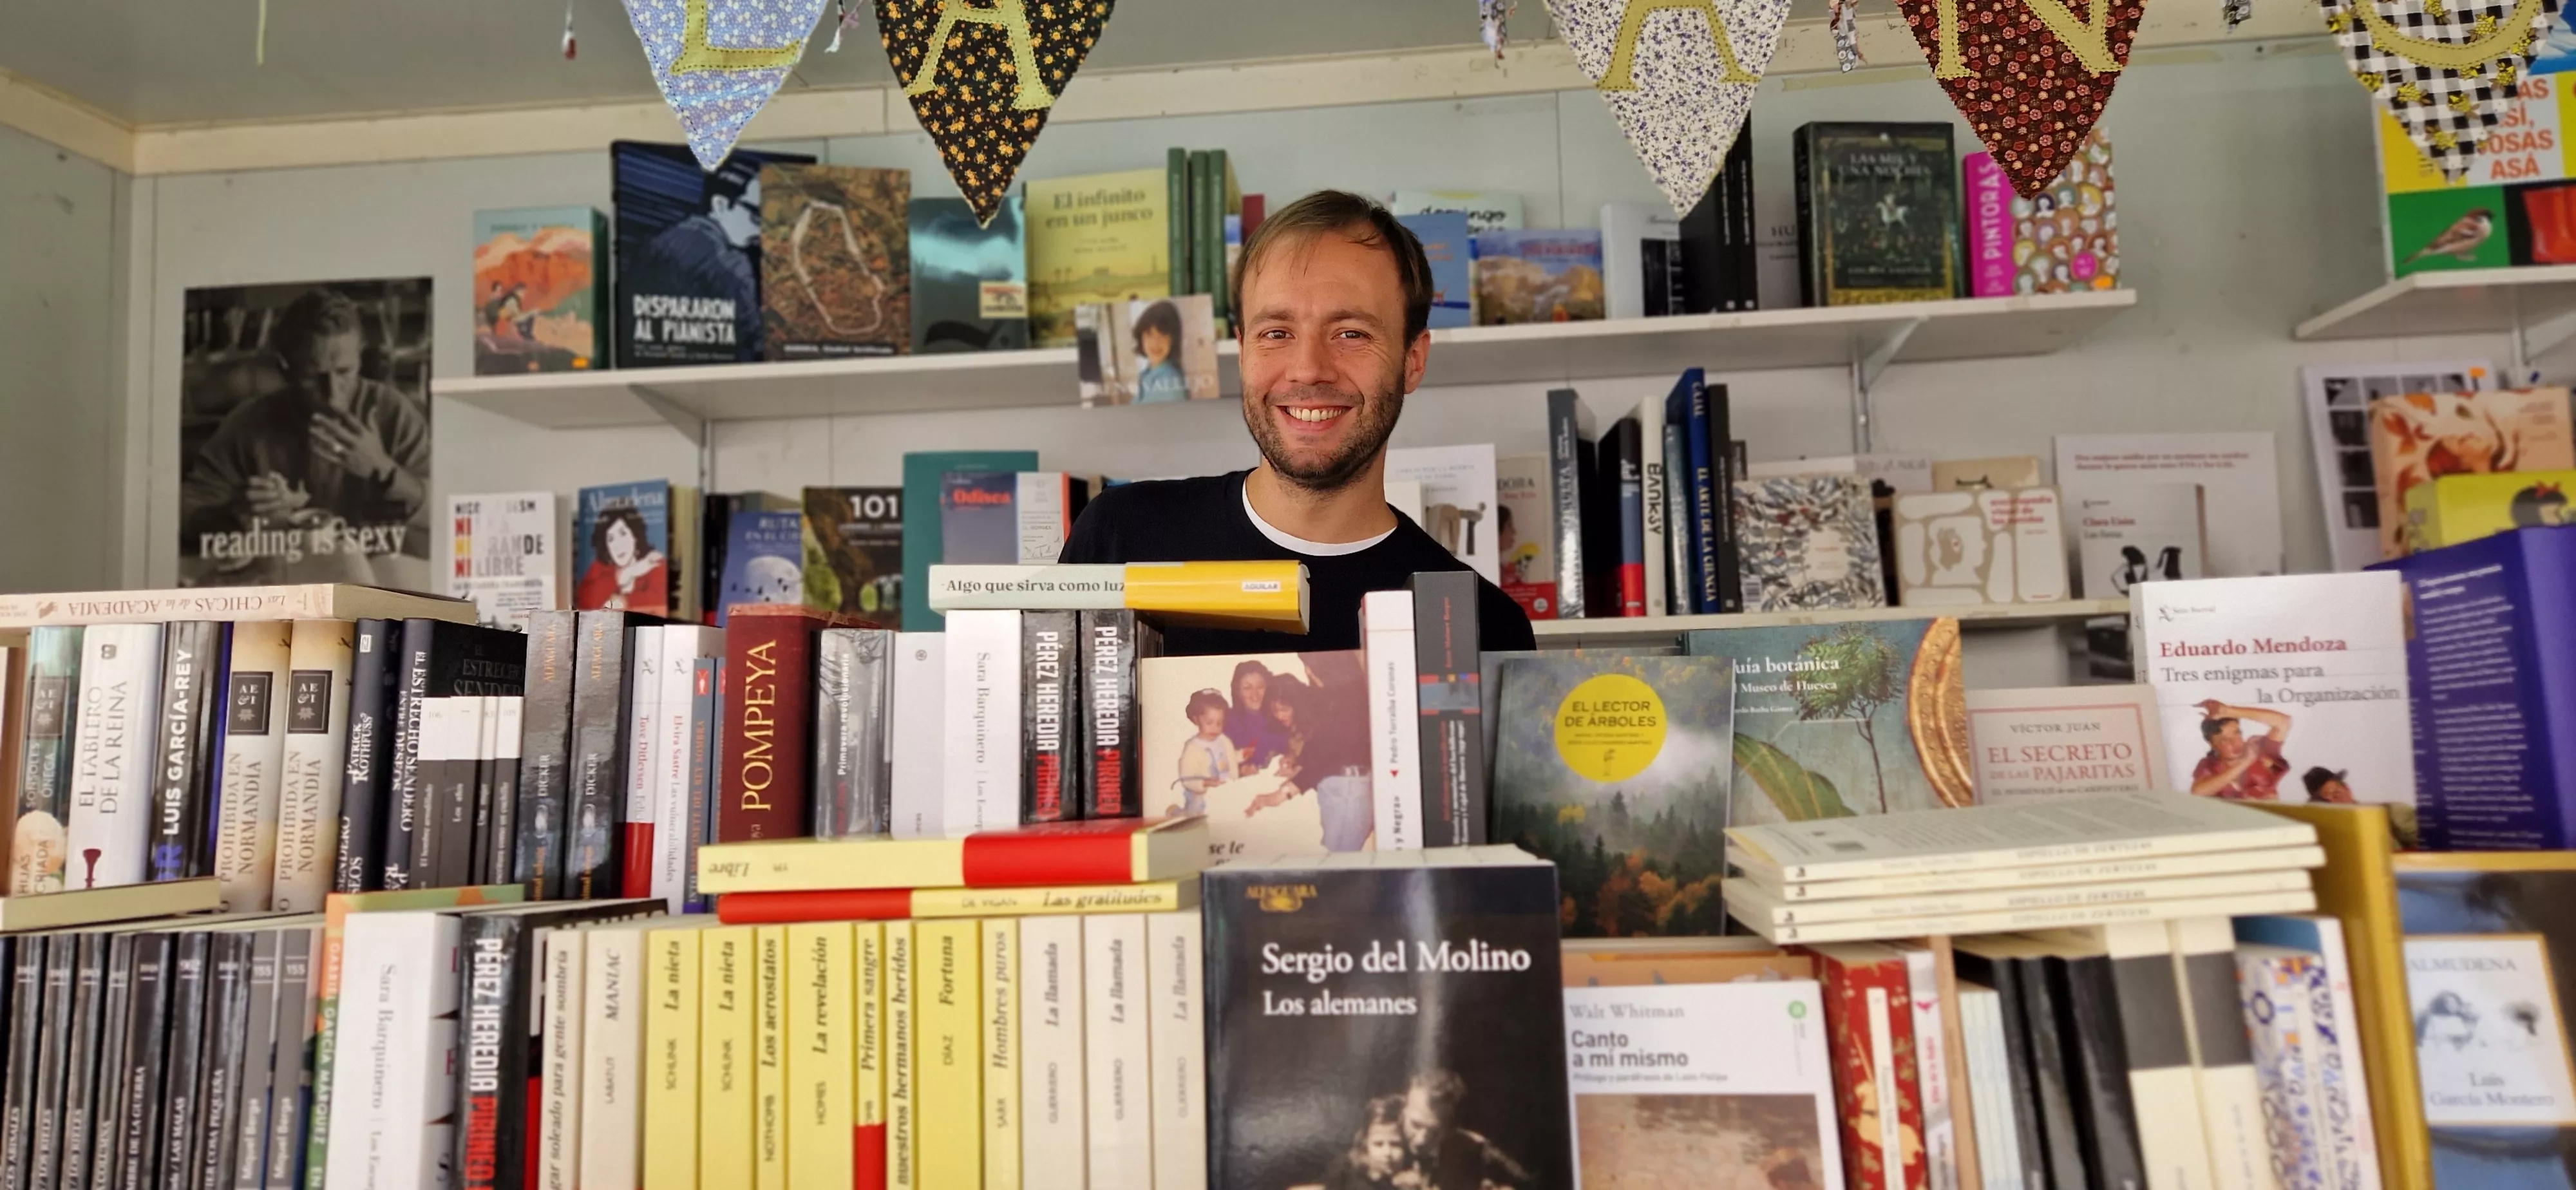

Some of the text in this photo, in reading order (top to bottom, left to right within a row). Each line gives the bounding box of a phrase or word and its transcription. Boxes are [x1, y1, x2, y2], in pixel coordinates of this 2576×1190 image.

[2491, 154, 2541, 180] ASÁ
[1046, 218, 1068, 229] en
[1074, 216, 1096, 228] un
[1053, 188, 1146, 209] El infinito
[1981, 162, 2001, 259] PINTORAS
[632, 294, 735, 319] DISPARARON
[633, 320, 736, 344] AL PIANISTA
[849, 495, 898, 518] 101
[201, 518, 407, 562] reading is sexy
[1697, 468, 1716, 601] EL ARTE DE LA CIENCIA
[68, 594, 287, 616] Las CHICAS de la ACADEMIA
[946, 579, 1126, 595] Algo que sirva como luz
[1766, 656, 1840, 674] botánica
[2161, 636, 2347, 658] Eduardo Mendoza
[1036, 631, 1060, 751] PÉREZ HEREDIA
[1741, 679, 1838, 694] Museo de Huesca
[2161, 665, 2325, 684] Tres enigmas para
[2257, 685, 2400, 705] la Organización
[166, 648, 193, 781] GARCÍA-REY
[741, 639, 777, 811] POMPEYA
[974, 652, 990, 764] Sara Barquinero
[1095, 626, 1121, 814] PÉREZ HEREDIA PIRINEO
[1564, 713, 1657, 728] DE ÁRBOLES
[1572, 699, 1651, 713] EL LECTOR
[2009, 722, 2061, 733] VÍCTOR
[79, 685, 104, 808] EL TABLERO
[101, 680, 128, 815] DE LA REINA
[838, 719, 848, 775] Primavera
[1987, 742, 2132, 764] EL SECRETO
[537, 754, 550, 797] DICKER
[585, 753, 598, 796] DICKER
[2033, 763, 2136, 782] PAJARITAS
[162, 784, 181, 835] LUIS
[219, 751, 242, 883] PROHIBIDA EN
[238, 760, 262, 874] NORMANDÍA
[279, 749, 302, 882] PROHIBIDA EN
[298, 757, 322, 872] NORMANDÍA
[665, 715, 683, 882] Elvira Sastre Las vulnerabilidades
[709, 863, 750, 877] Libre
[1208, 839, 1244, 855] se te
[663, 940, 680, 1012] La nieta
[718, 940, 735, 1012] La nieta
[891, 937, 907, 1004] heridos
[939, 935, 954, 1006] Fortuna
[1110, 939, 1124, 1023] La llamada
[1262, 938, 1531, 983] Sergio del Molino
[606, 949, 621, 1022] MANIAC
[762, 939, 777, 1068] Los aerostatos
[811, 936, 827, 1054] La revelación
[860, 938, 878, 1071] Primera sangre
[992, 931, 1011, 1070] Hombres puros
[1045, 943, 1059, 1028] La llamada
[1262, 990, 1418, 1016] Los alemanes
[1569, 1004, 1685, 1019] Walt Whitman
[371, 964, 397, 1110] Sara Barquinero
[465, 938, 503, 1180] PÉREZ HEREDIA PIRINEO
[547, 949, 568, 1151] soleado para gente sombría
[894, 1006, 909, 1100] hermanos
[1571, 1030, 1629, 1049] Canto
[1572, 1049, 1689, 1068] a mí mismo
[2429, 1090, 2555, 1107] García Montero
[2469, 1072, 2505, 1088] Luis
[172, 1096, 185, 1137] MALAS
